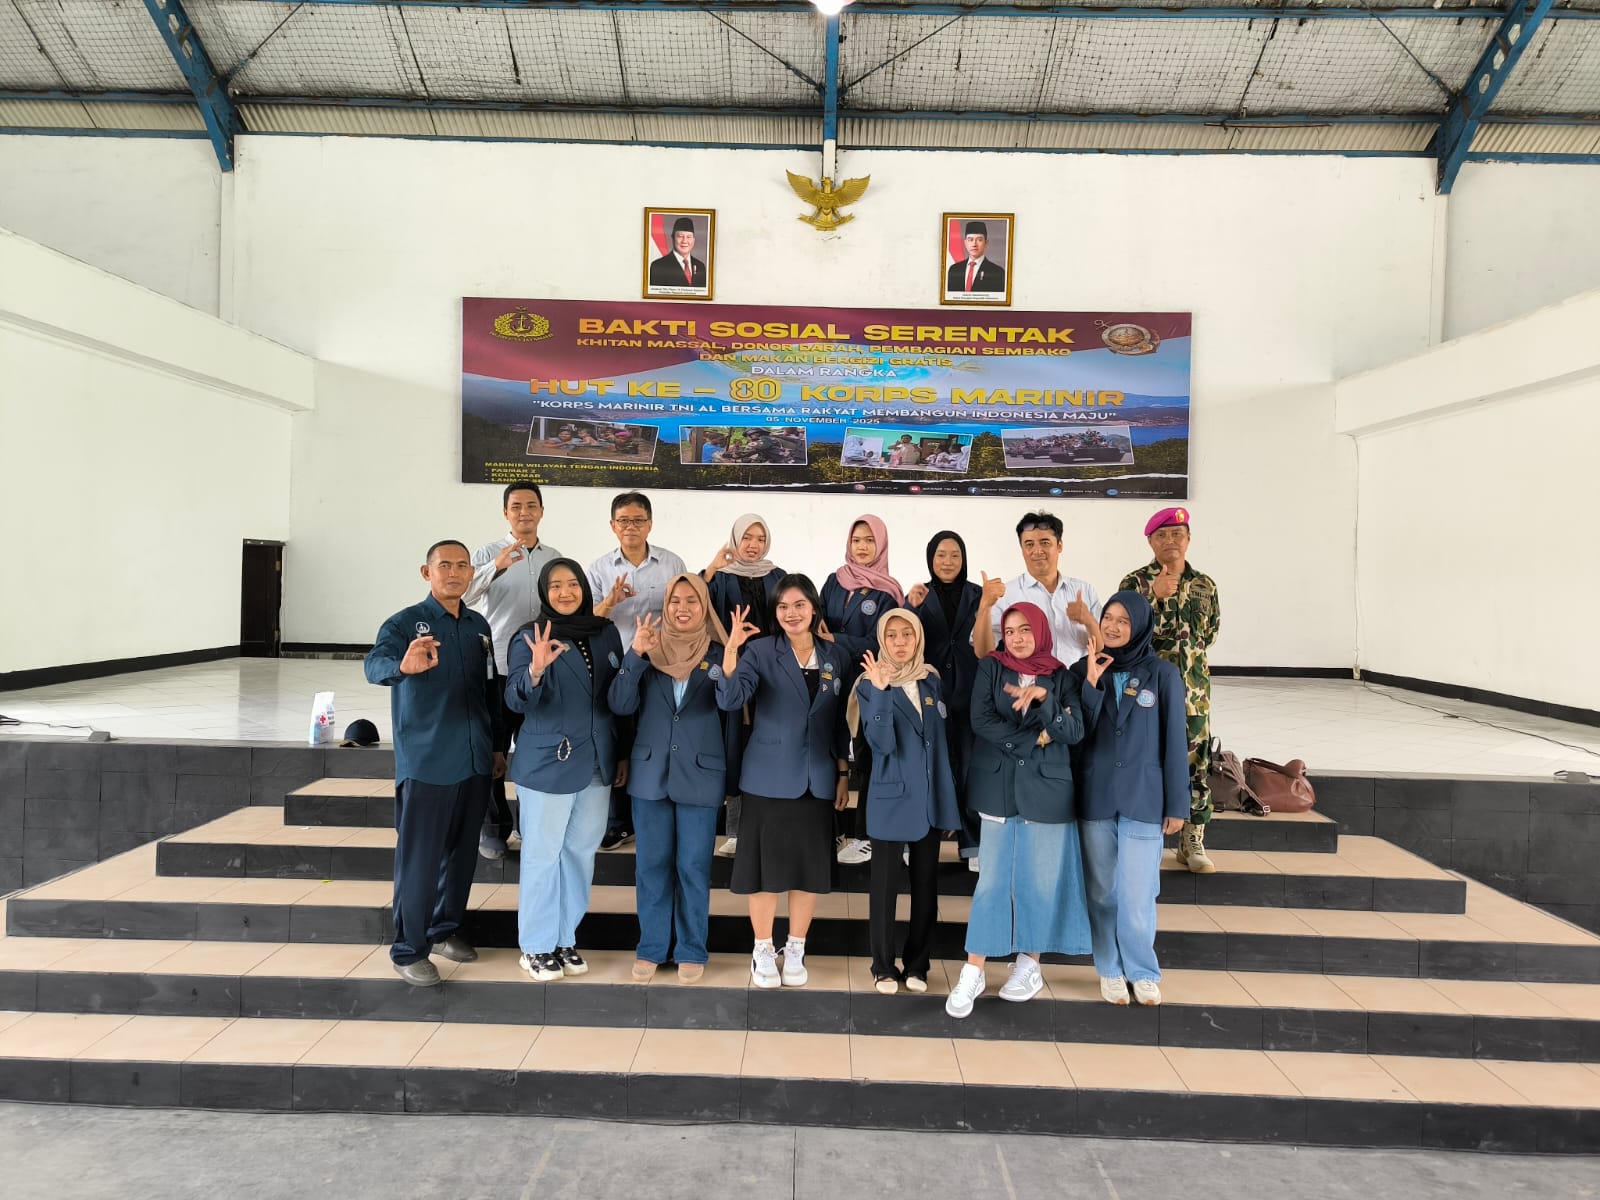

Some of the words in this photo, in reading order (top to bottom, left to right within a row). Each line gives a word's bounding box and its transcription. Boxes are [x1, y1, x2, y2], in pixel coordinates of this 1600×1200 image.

[578, 318, 697, 336] BAKTI
[709, 321, 851, 340] SOSIAL
[863, 325, 1075, 344] SERENTAK
[577, 338, 642, 348] KHITAN
[647, 340, 726, 351] MASSAL,
[732, 342, 793, 351] DONOR
[799, 343, 864, 355] DARAH,
[869, 345, 977, 355] PEMBAGIAN
[982, 347, 1072, 357] SEMBAKO
[699, 353, 736, 362] DAN
[741, 354, 808, 364] MAKAN
[813, 356, 884, 366] BERGIZI
[889, 357, 953, 367] GRATIS
[751, 366, 814, 376] DALAM
[819, 367, 897, 378] RANGKA
[529, 378, 616, 396] HUT
[628, 380, 681, 399] KE
[730, 377, 782, 402] 80
[801, 384, 938, 404] KORPS
[950, 387, 1125, 407] MARINIR
[598, 402, 665, 411] MARINIR
[671, 404, 694, 412] TNI
[698, 404, 718, 412] AL
[722, 405, 796, 414] BERSAMA
[801, 407, 857, 416] RAKYAT
[862, 408, 968, 418] MEMBANGUN
[972, 410, 1058, 420] INDONESIA
[785, 416, 847, 424] NOVEMBER
